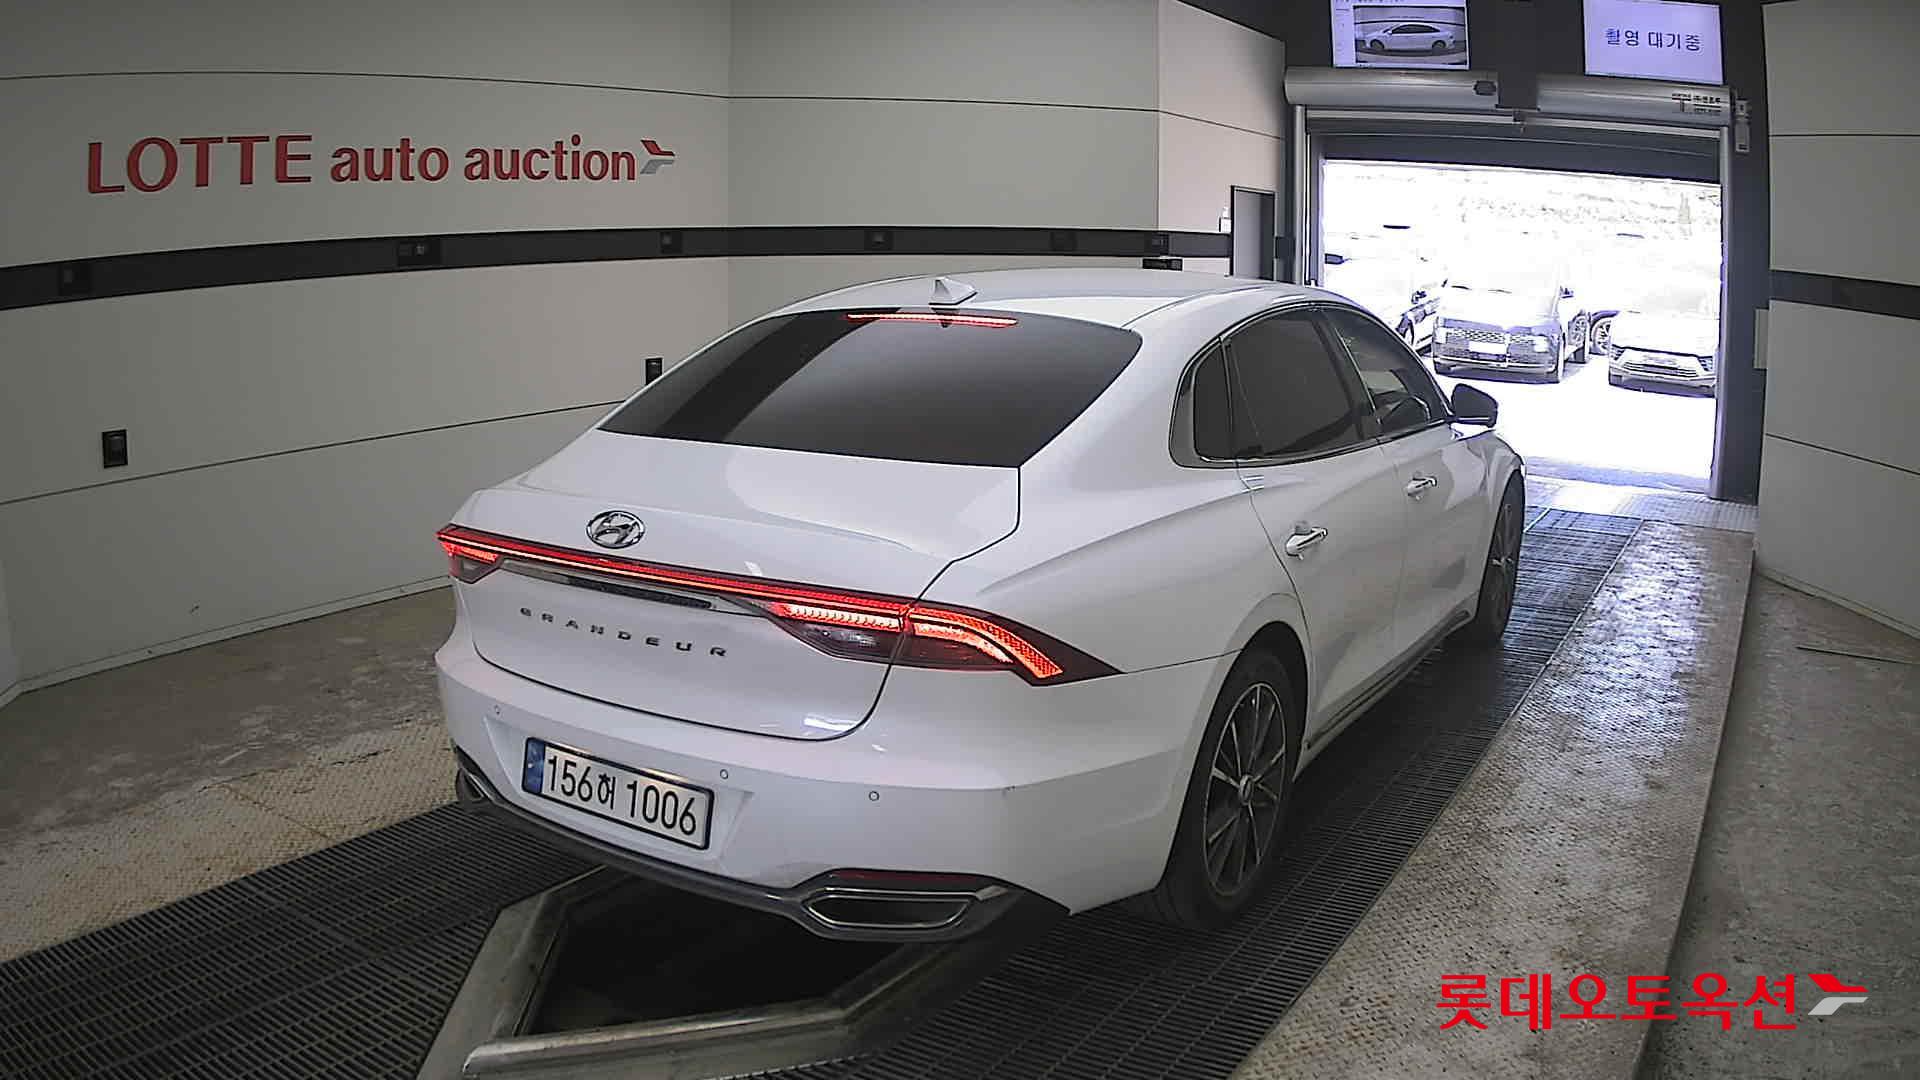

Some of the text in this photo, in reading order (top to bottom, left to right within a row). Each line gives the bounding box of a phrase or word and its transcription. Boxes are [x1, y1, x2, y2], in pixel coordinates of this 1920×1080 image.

[1647, 31, 1702, 52] 대기중
[87, 133, 637, 194] LOTTE auto auction
[519, 606, 728, 657] GRANDEUR
[547, 754, 697, 836] 156허 1006
